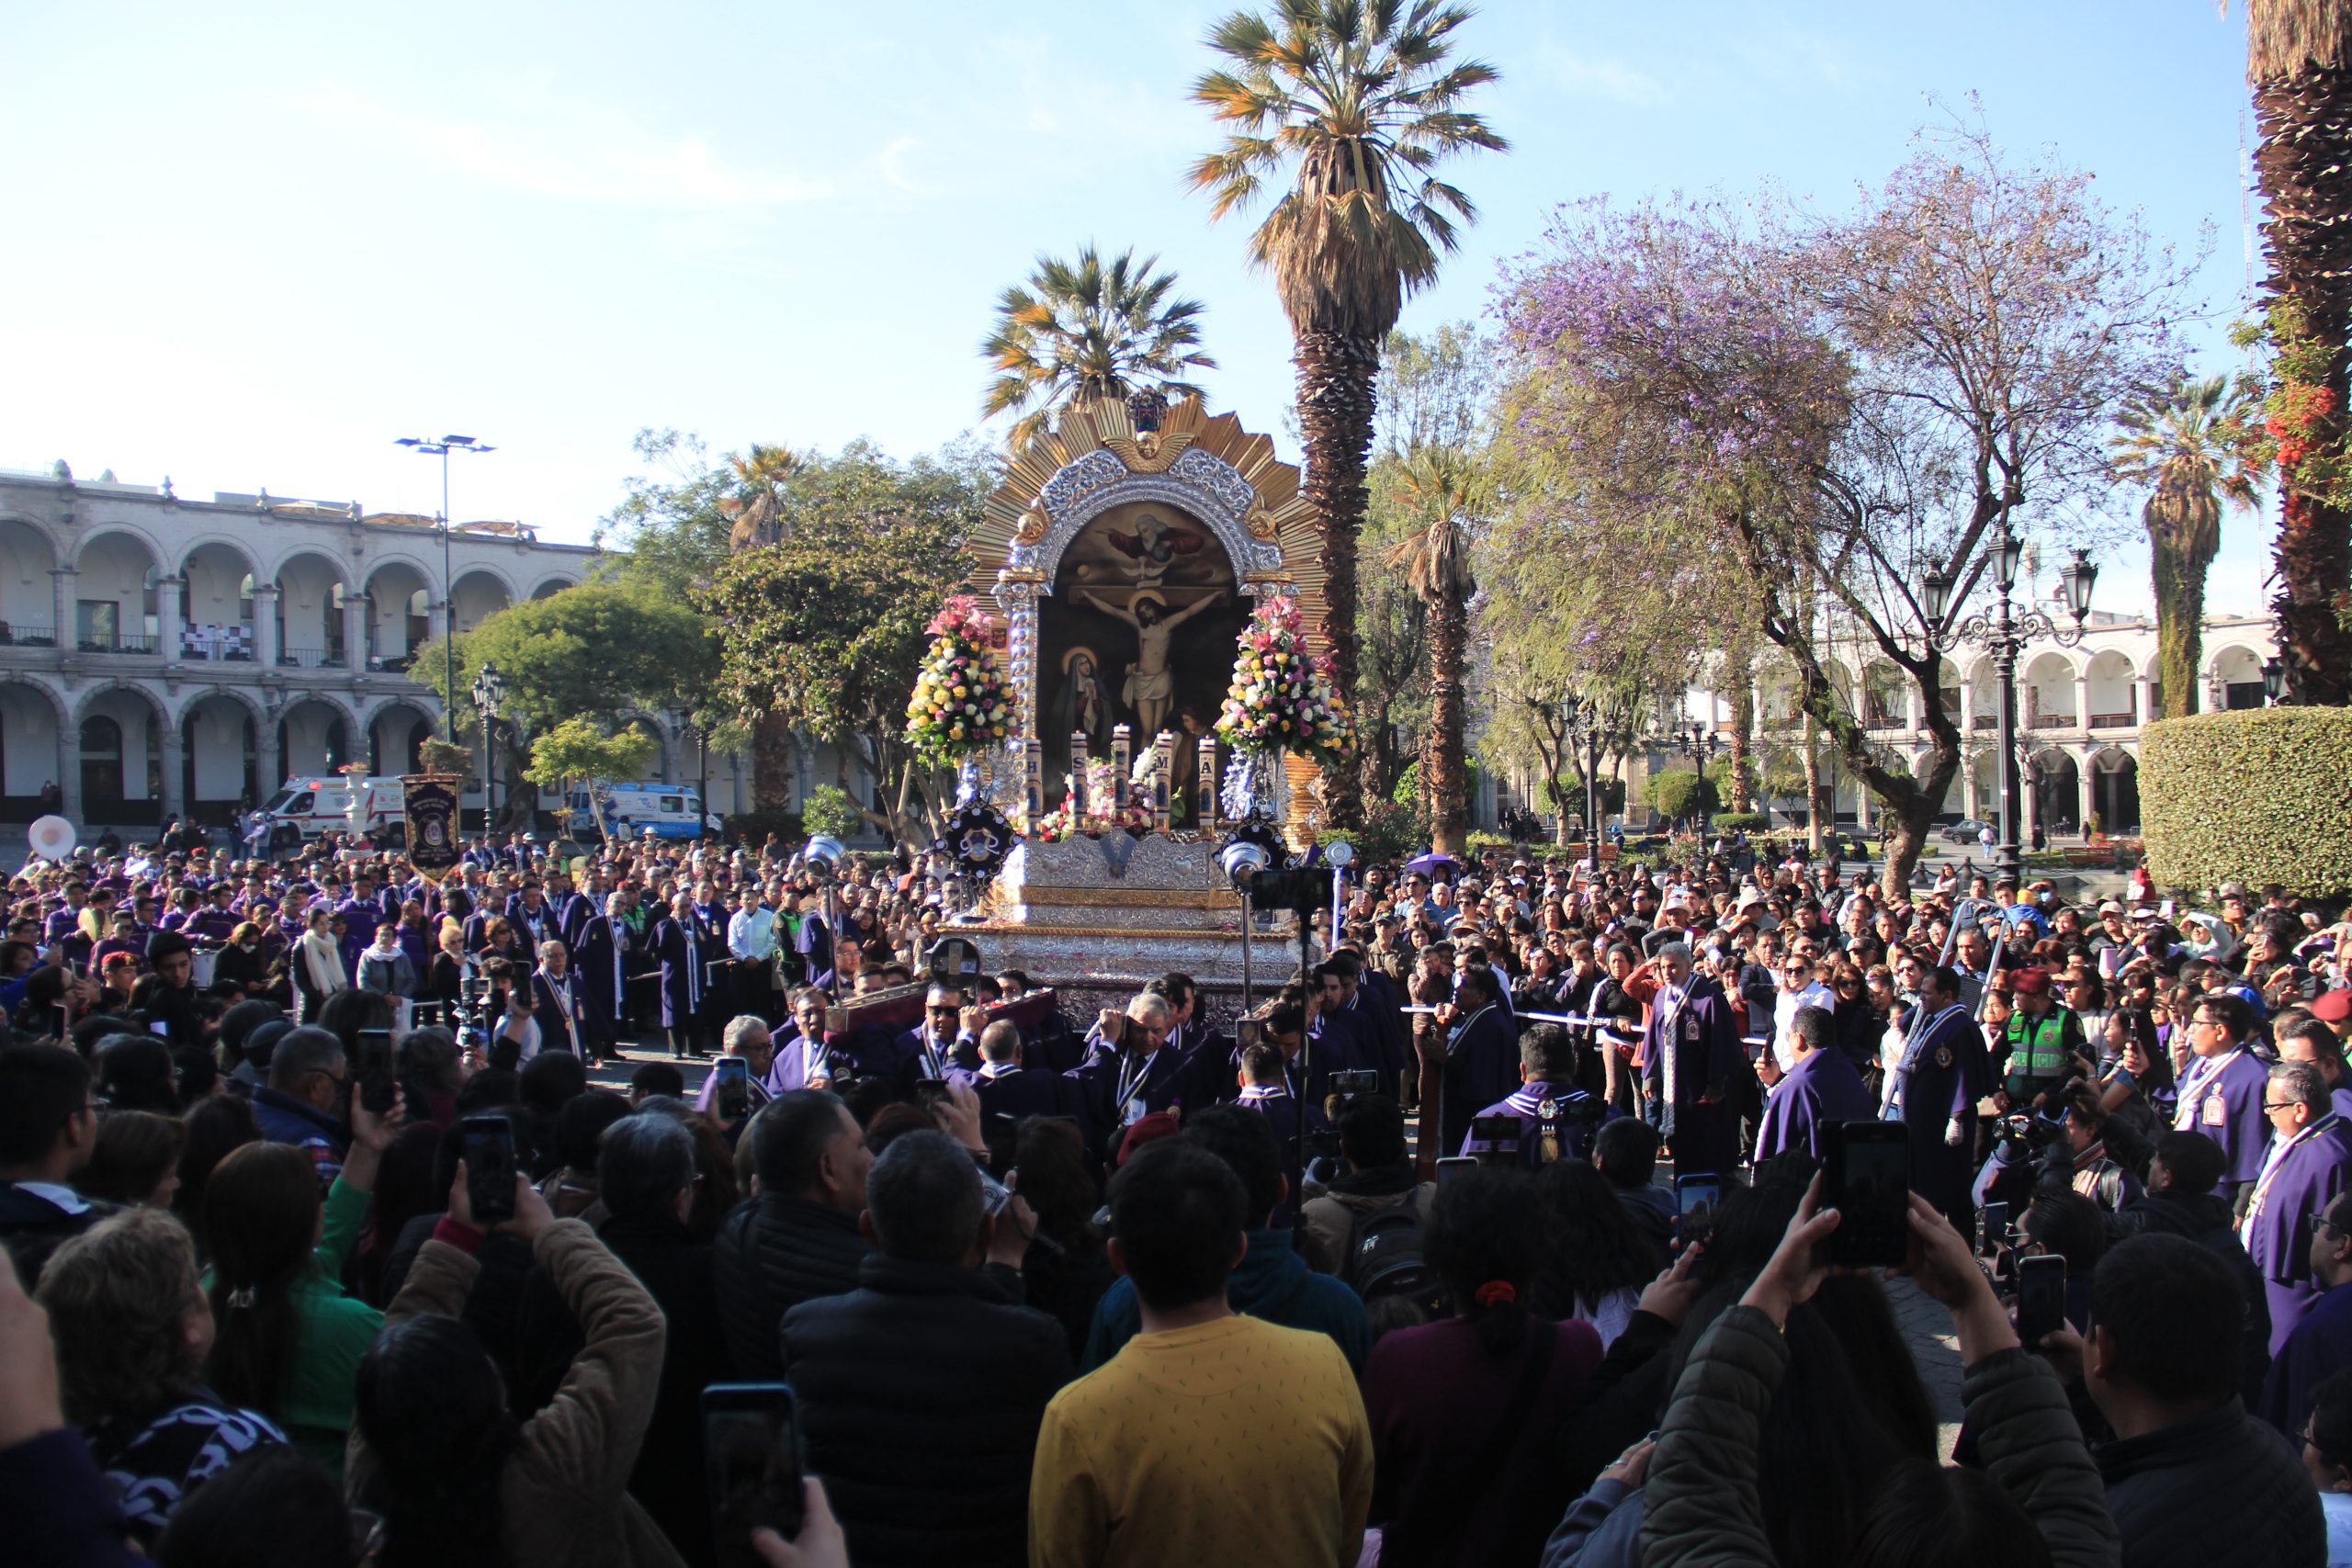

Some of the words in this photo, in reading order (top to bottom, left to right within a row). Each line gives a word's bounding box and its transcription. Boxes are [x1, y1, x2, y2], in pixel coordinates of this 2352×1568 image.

[1073, 757, 1085, 769] S
[1157, 757, 1169, 769] M
[1200, 761, 1213, 774] A
[2013, 1052, 2059, 1068] OLICIA
